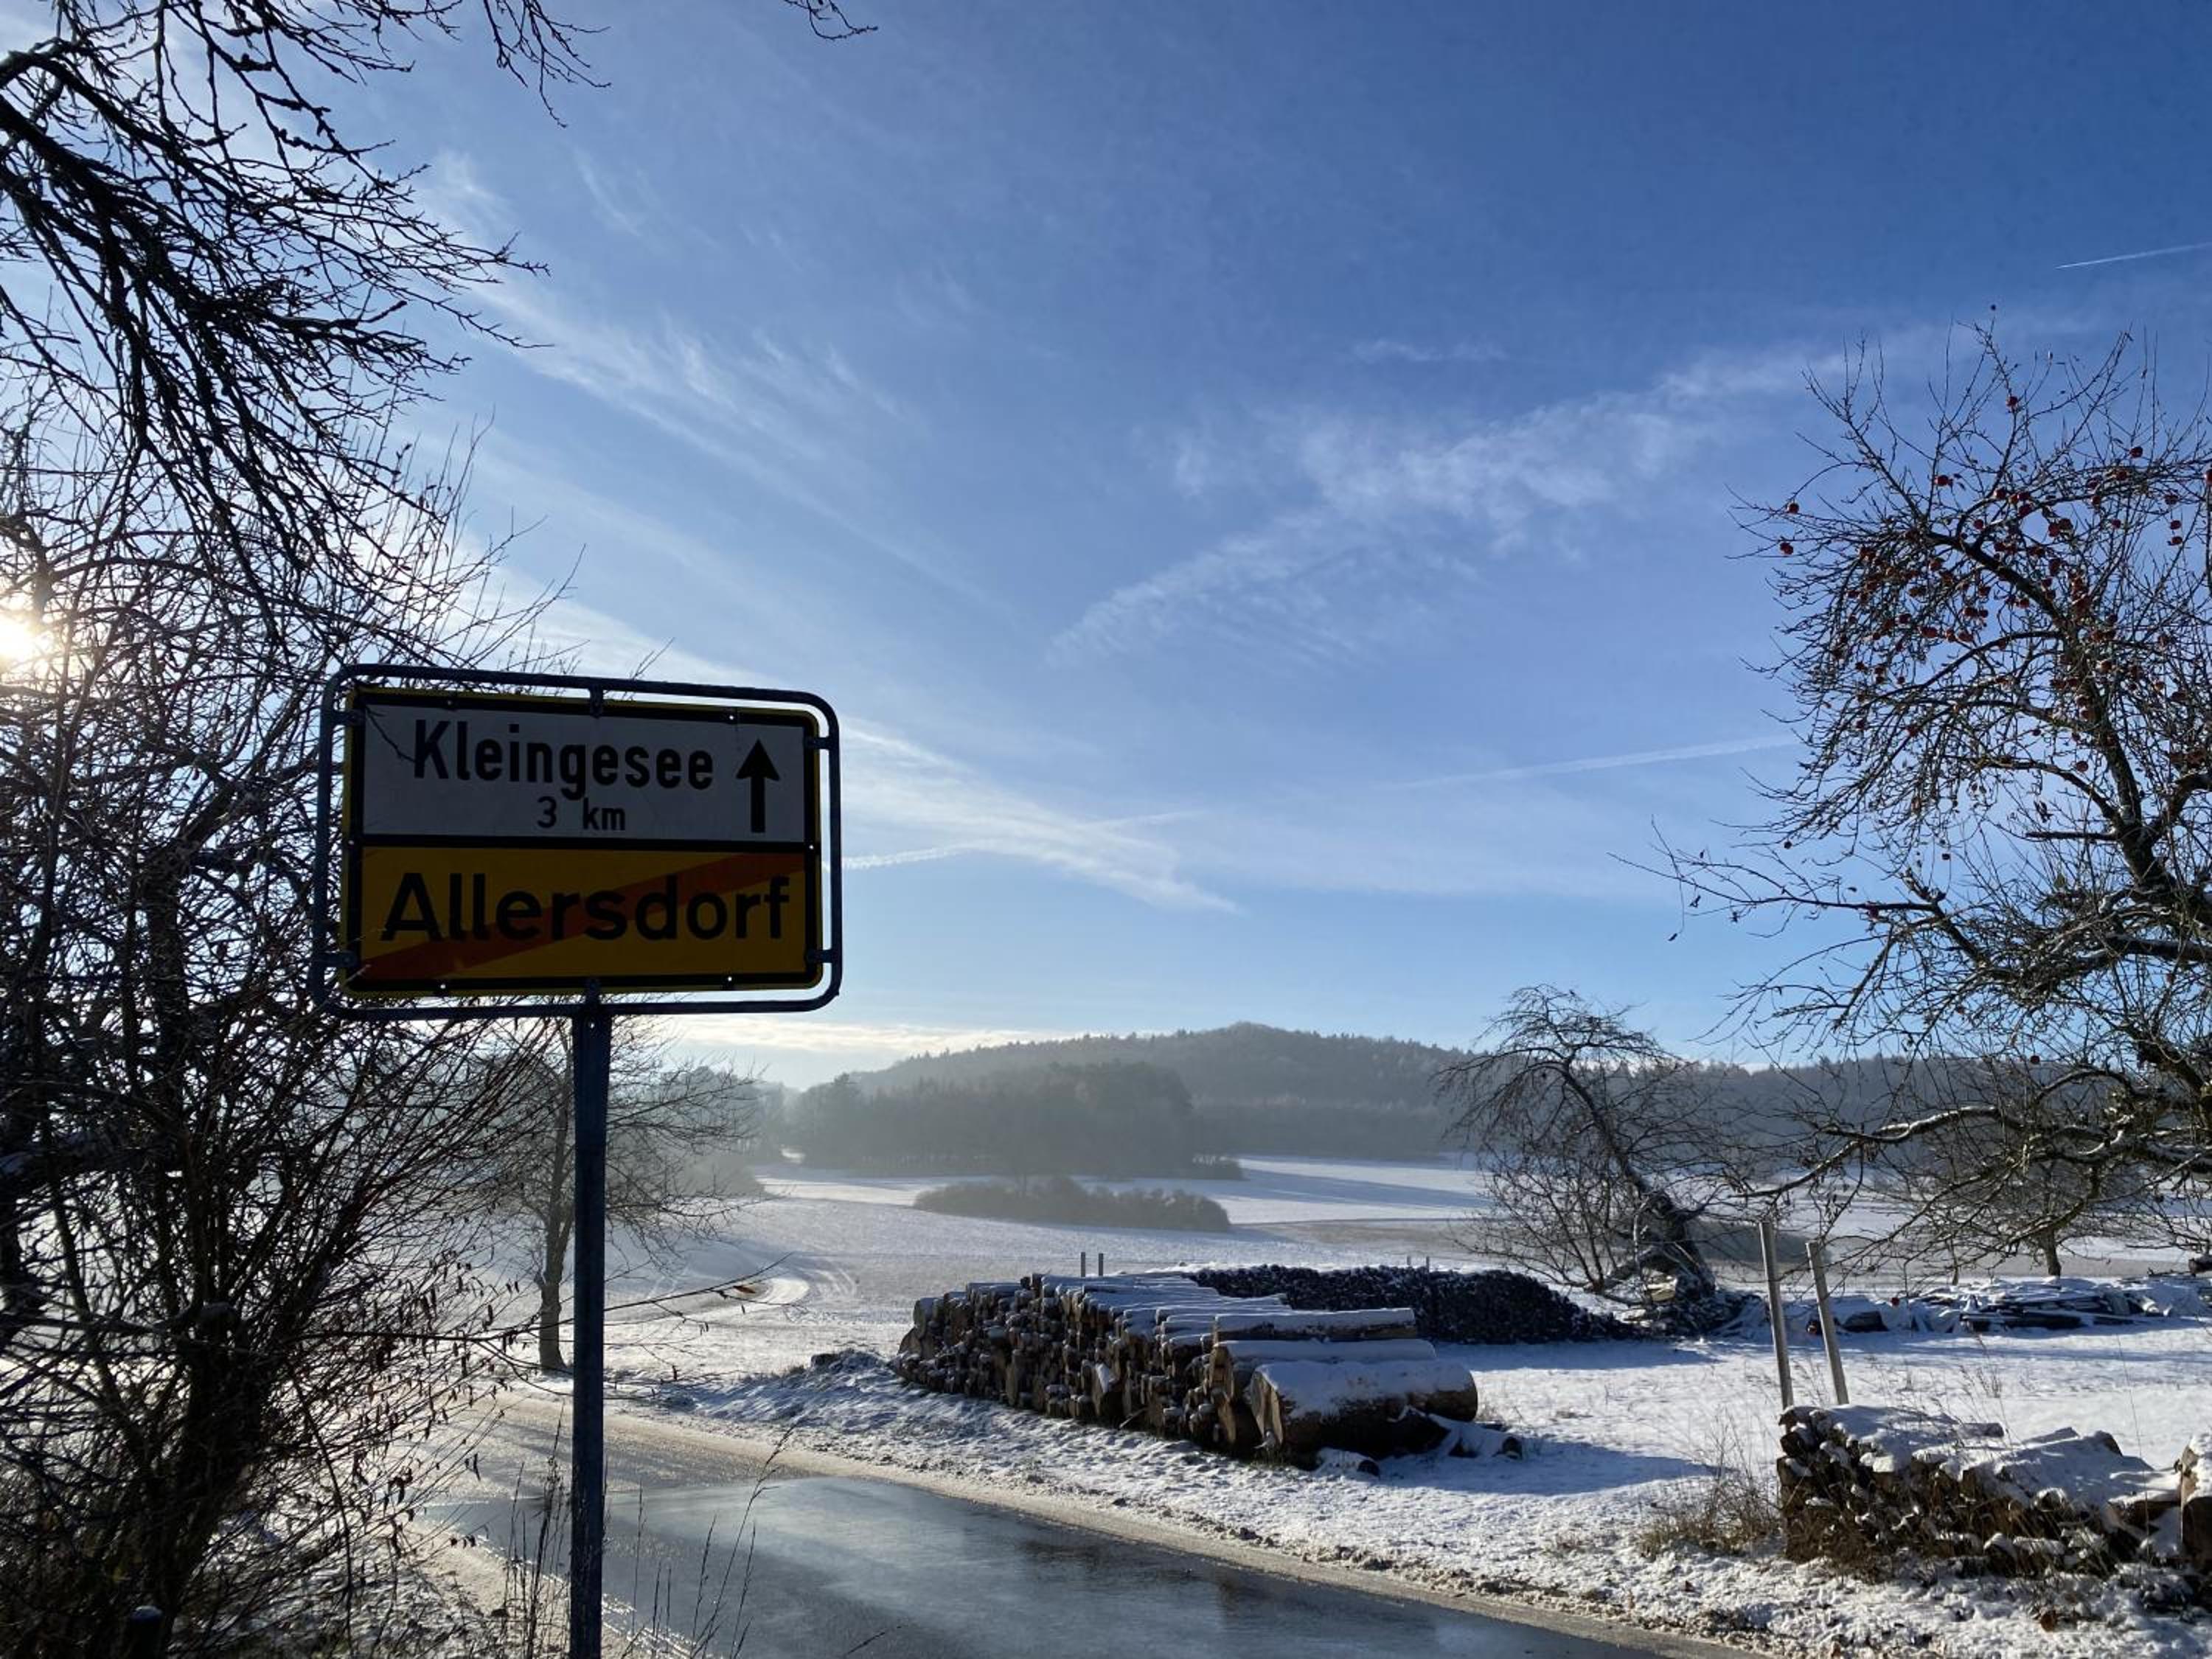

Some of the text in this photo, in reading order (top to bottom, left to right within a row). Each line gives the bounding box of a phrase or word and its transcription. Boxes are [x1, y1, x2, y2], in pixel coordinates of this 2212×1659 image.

[414, 719, 714, 801] Kleingesee
[537, 796, 626, 832] 3 km
[380, 872, 790, 942] Allersdorf
